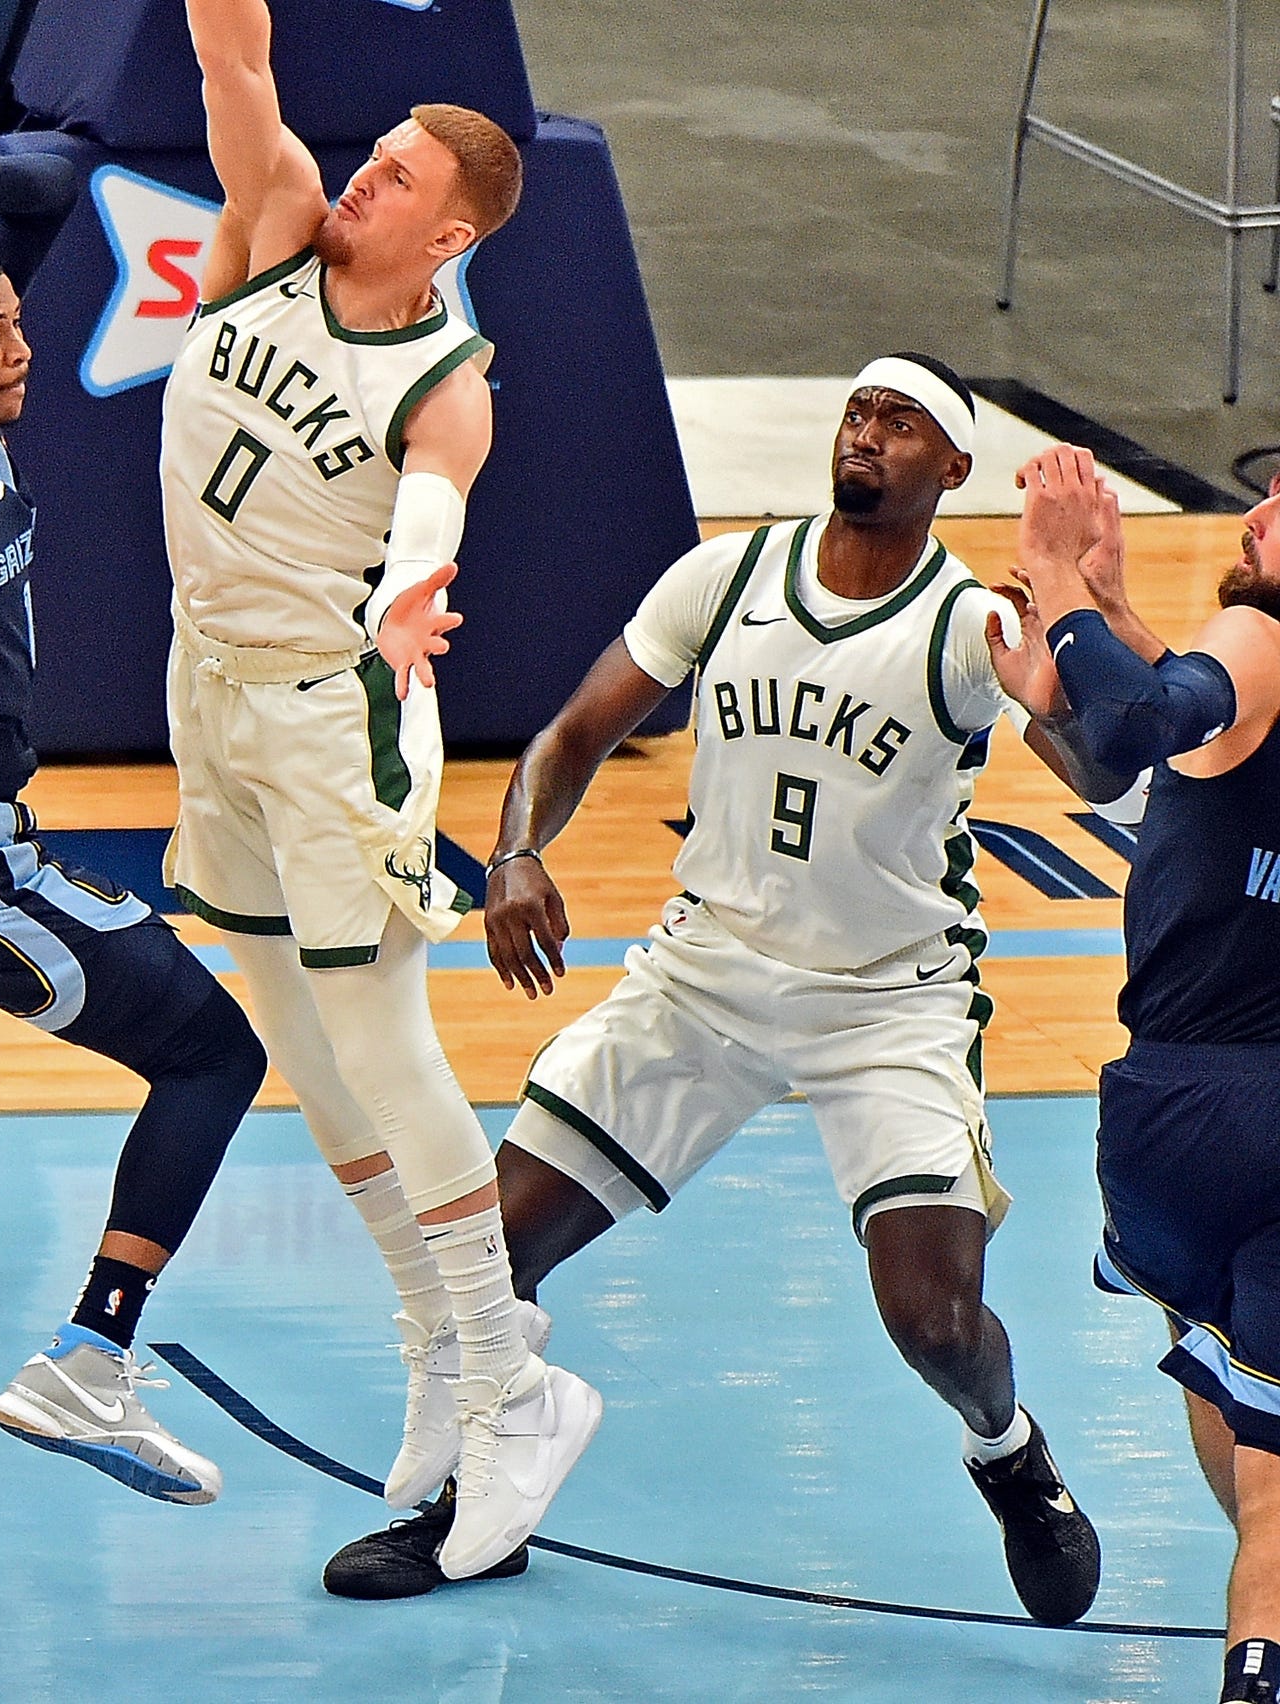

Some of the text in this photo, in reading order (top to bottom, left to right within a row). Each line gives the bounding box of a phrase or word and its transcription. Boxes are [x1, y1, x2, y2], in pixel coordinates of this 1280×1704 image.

[208, 322, 376, 482] BUCKS
[200, 427, 273, 524] 0
[714, 677, 912, 778] BUCKS
[769, 772, 820, 862] 9
